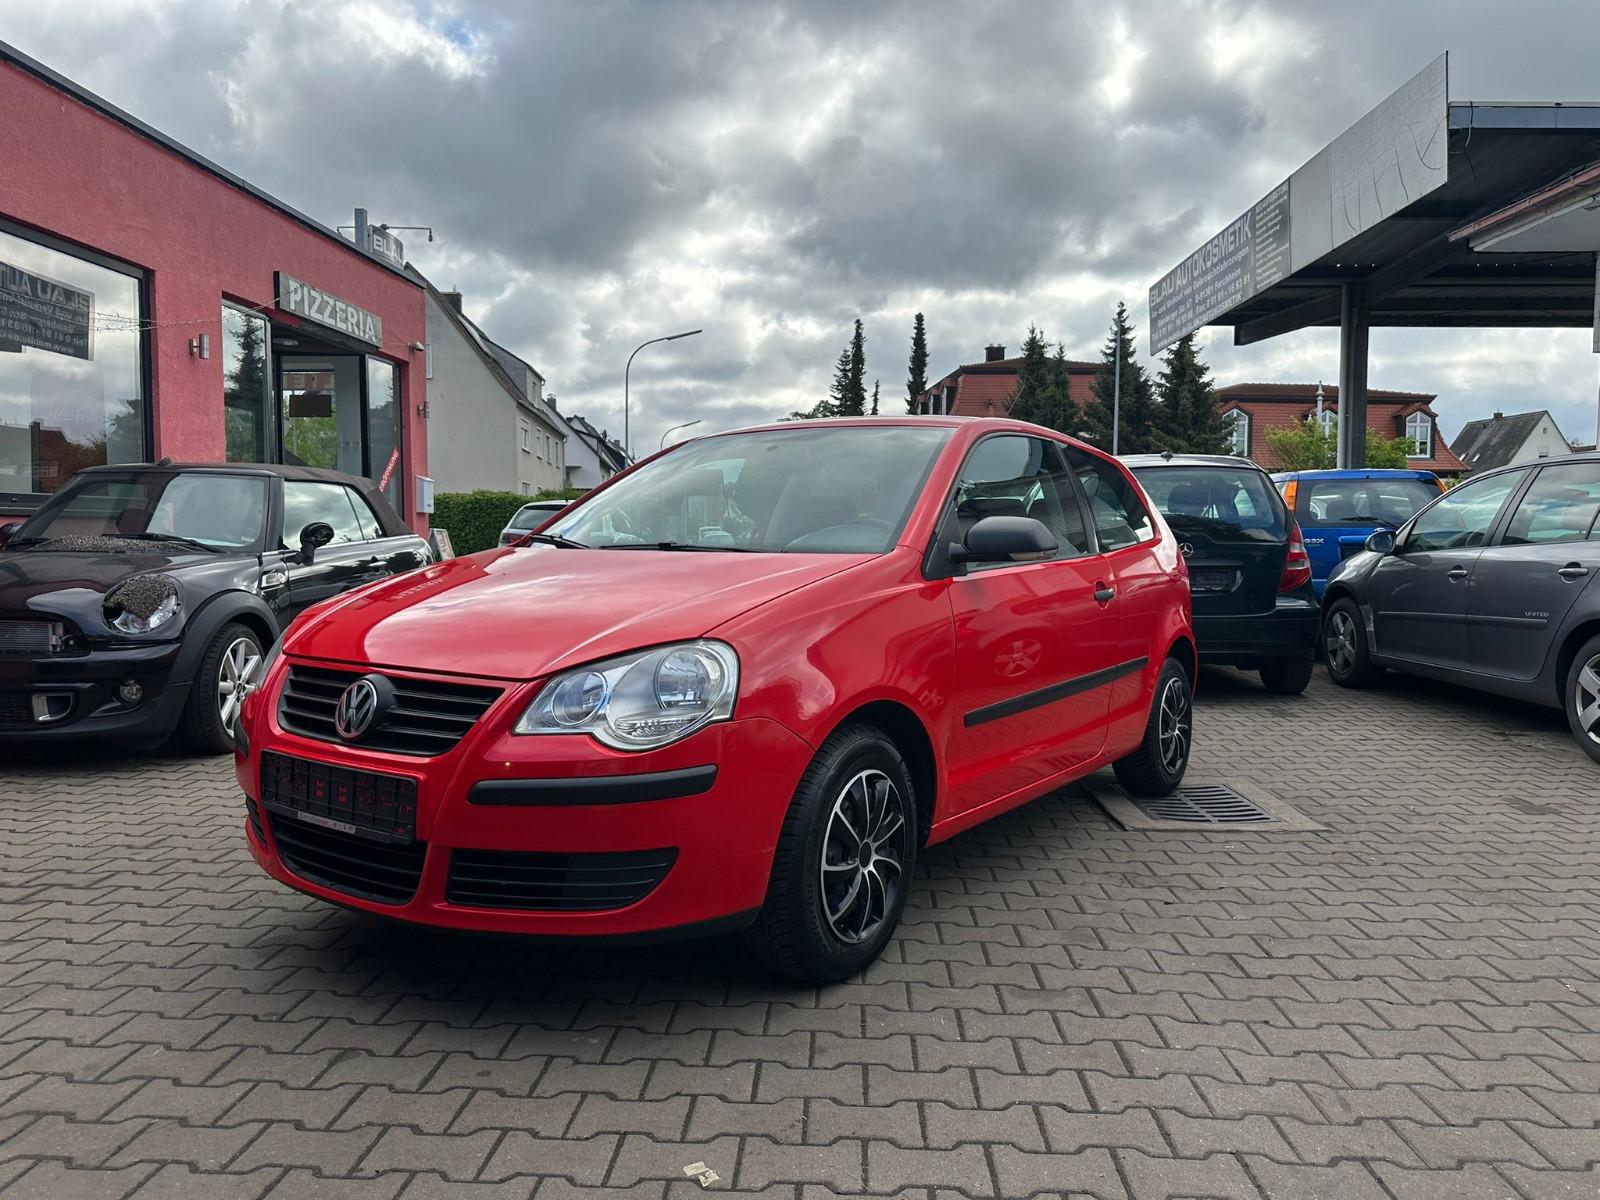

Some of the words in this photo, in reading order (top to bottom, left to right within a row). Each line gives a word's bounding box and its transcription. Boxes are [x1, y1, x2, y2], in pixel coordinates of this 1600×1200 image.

[1151, 275, 1175, 307] BLAU
[1176, 212, 1251, 291] AUTOKOSMETIK
[288, 279, 376, 342] PIZZERIA
[335, 679, 377, 739] VW
